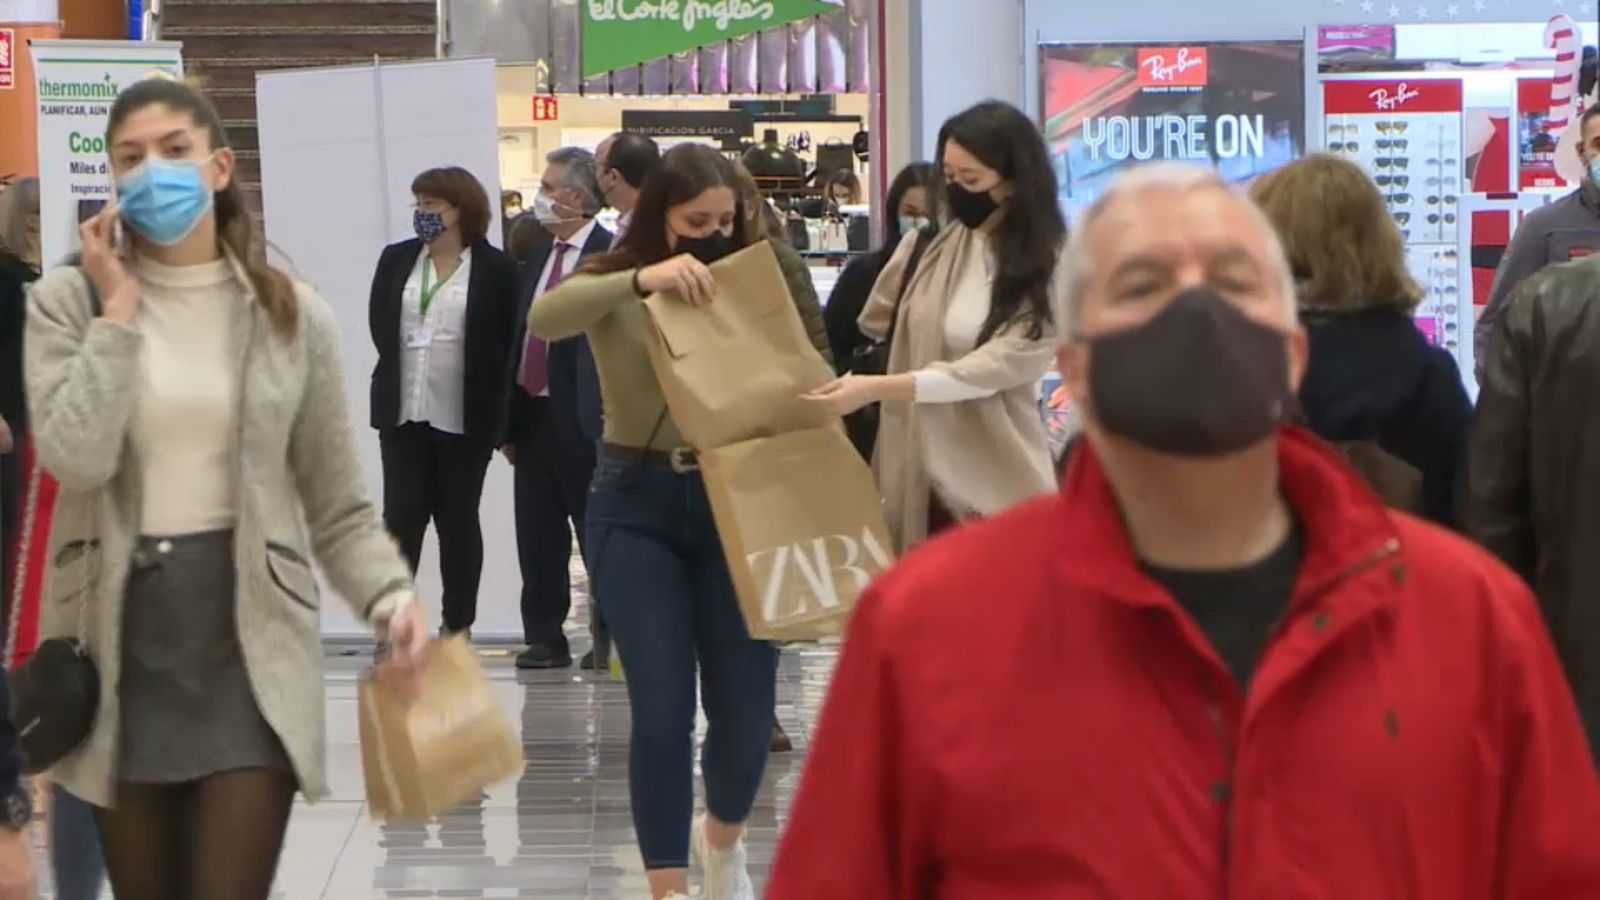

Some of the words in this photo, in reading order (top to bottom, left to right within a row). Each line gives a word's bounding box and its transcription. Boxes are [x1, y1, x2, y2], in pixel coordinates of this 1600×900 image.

[588, 0, 616, 21] El
[616, 0, 680, 21] Corte
[1141, 47, 1202, 81] Ray-Ban
[39, 73, 118, 97] thermomix
[1368, 82, 1420, 110] Ray-Ban
[1082, 114, 1208, 161] YOU'RE
[1215, 114, 1264, 159] ON
[70, 161, 96, 174] Miles
